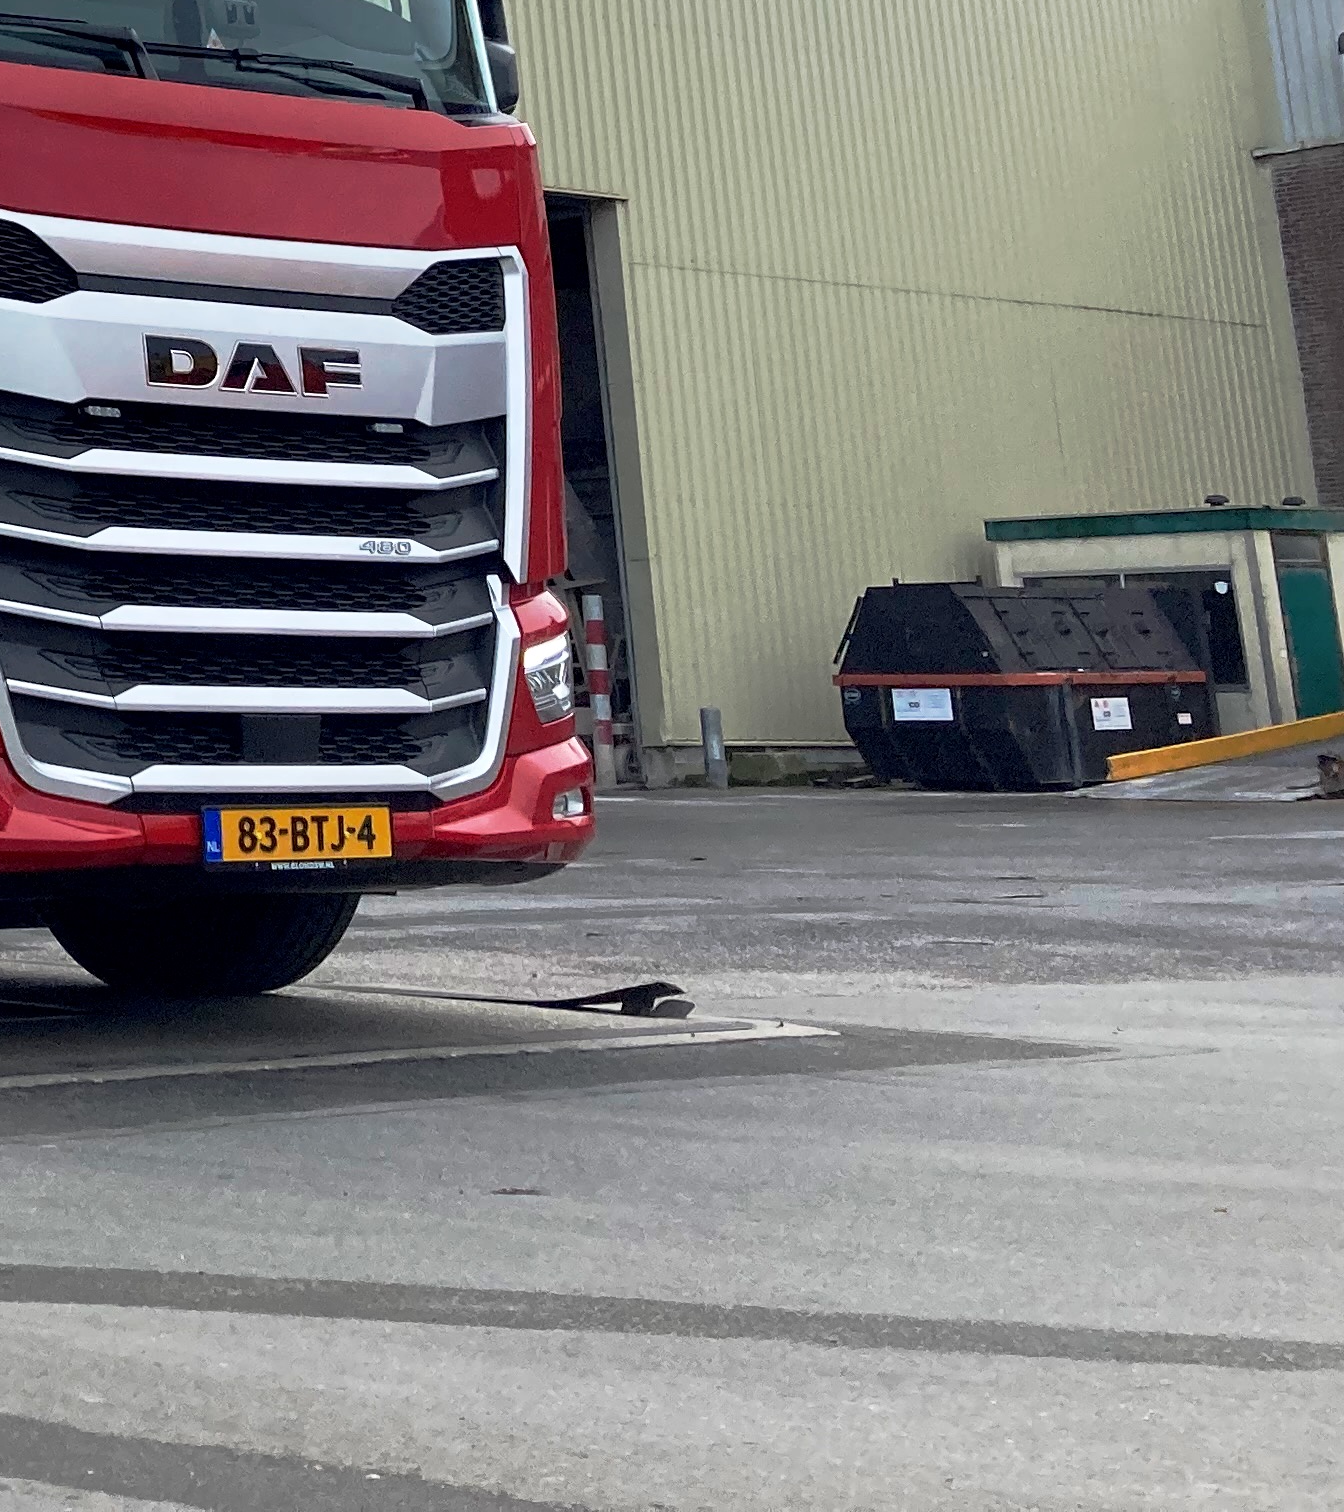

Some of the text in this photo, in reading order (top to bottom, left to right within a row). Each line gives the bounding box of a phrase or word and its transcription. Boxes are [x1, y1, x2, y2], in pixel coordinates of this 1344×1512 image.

[142, 332, 364, 398] DAF
[358, 540, 412, 556] 480
[207, 840, 221, 853] NL
[238, 815, 376, 854] 83-BTJ-4
